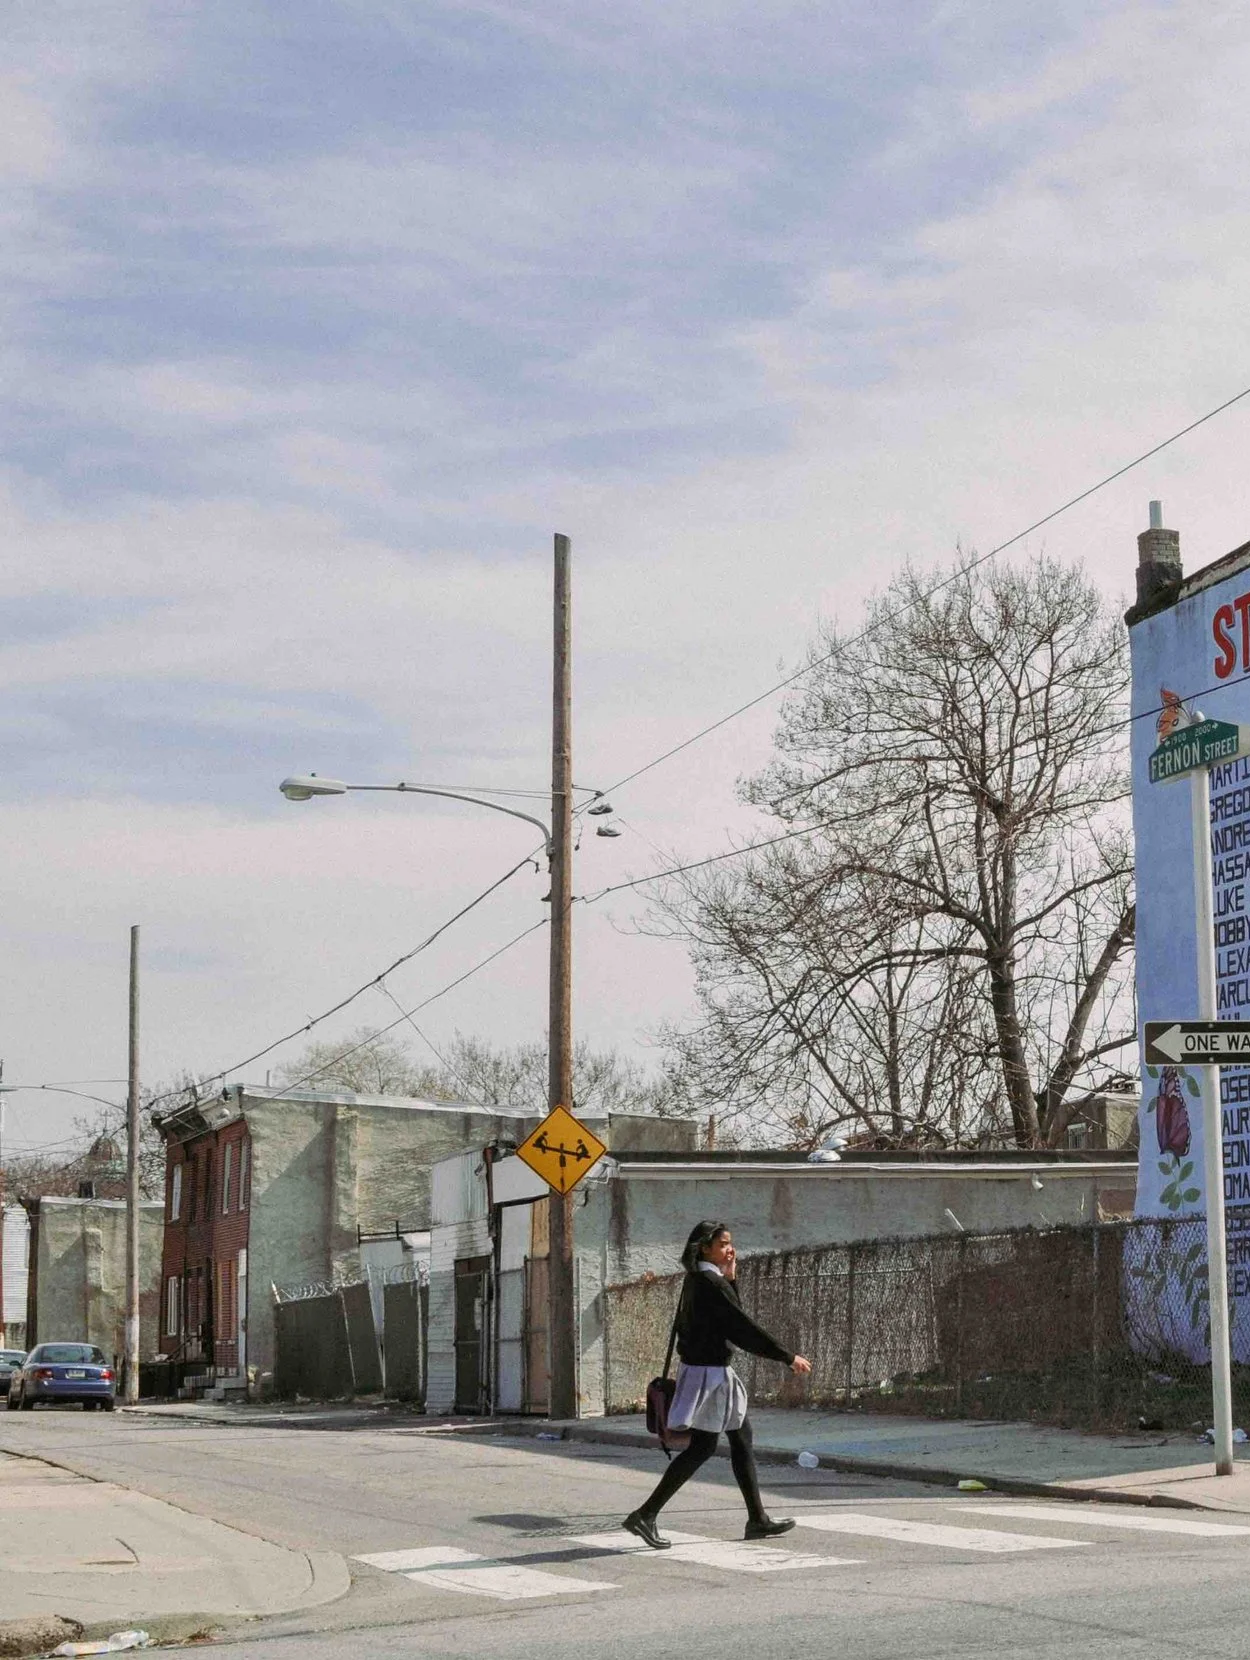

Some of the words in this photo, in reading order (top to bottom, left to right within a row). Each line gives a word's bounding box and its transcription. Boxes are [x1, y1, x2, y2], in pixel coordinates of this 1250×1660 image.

[1195, 723, 1211, 737] 2000
[1151, 740, 1200, 780] FERNON
[1204, 735, 1237, 761] STREET
[1213, 884, 1245, 918] UKE
[1184, 1034, 1220, 1051] ONE
[1222, 1139, 1250, 1168] EON
